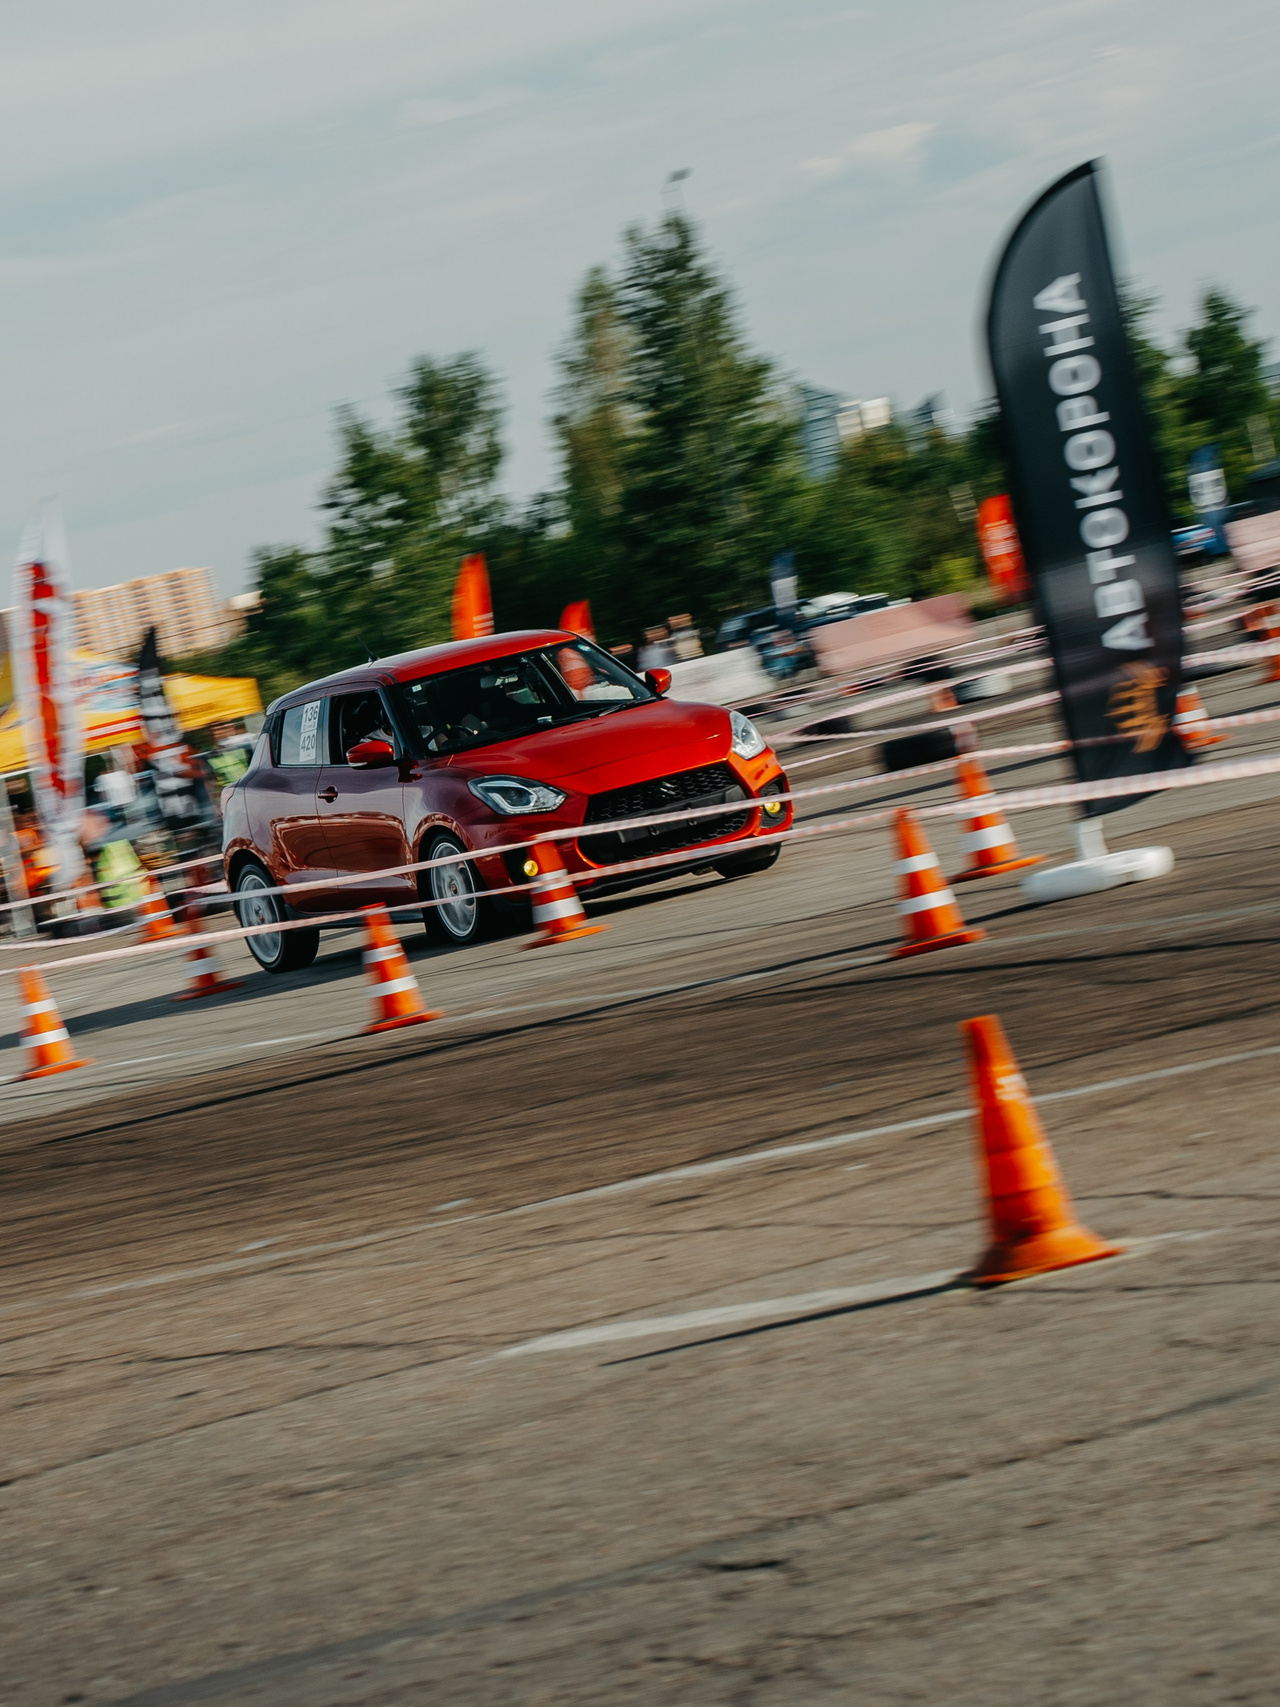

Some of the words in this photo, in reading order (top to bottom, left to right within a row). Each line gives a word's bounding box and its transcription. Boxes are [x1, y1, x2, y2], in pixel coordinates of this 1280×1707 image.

[1032, 271, 1155, 651] АВТОКОРОНА
[304, 704, 319, 723] 136
[301, 733, 316, 752] 420
